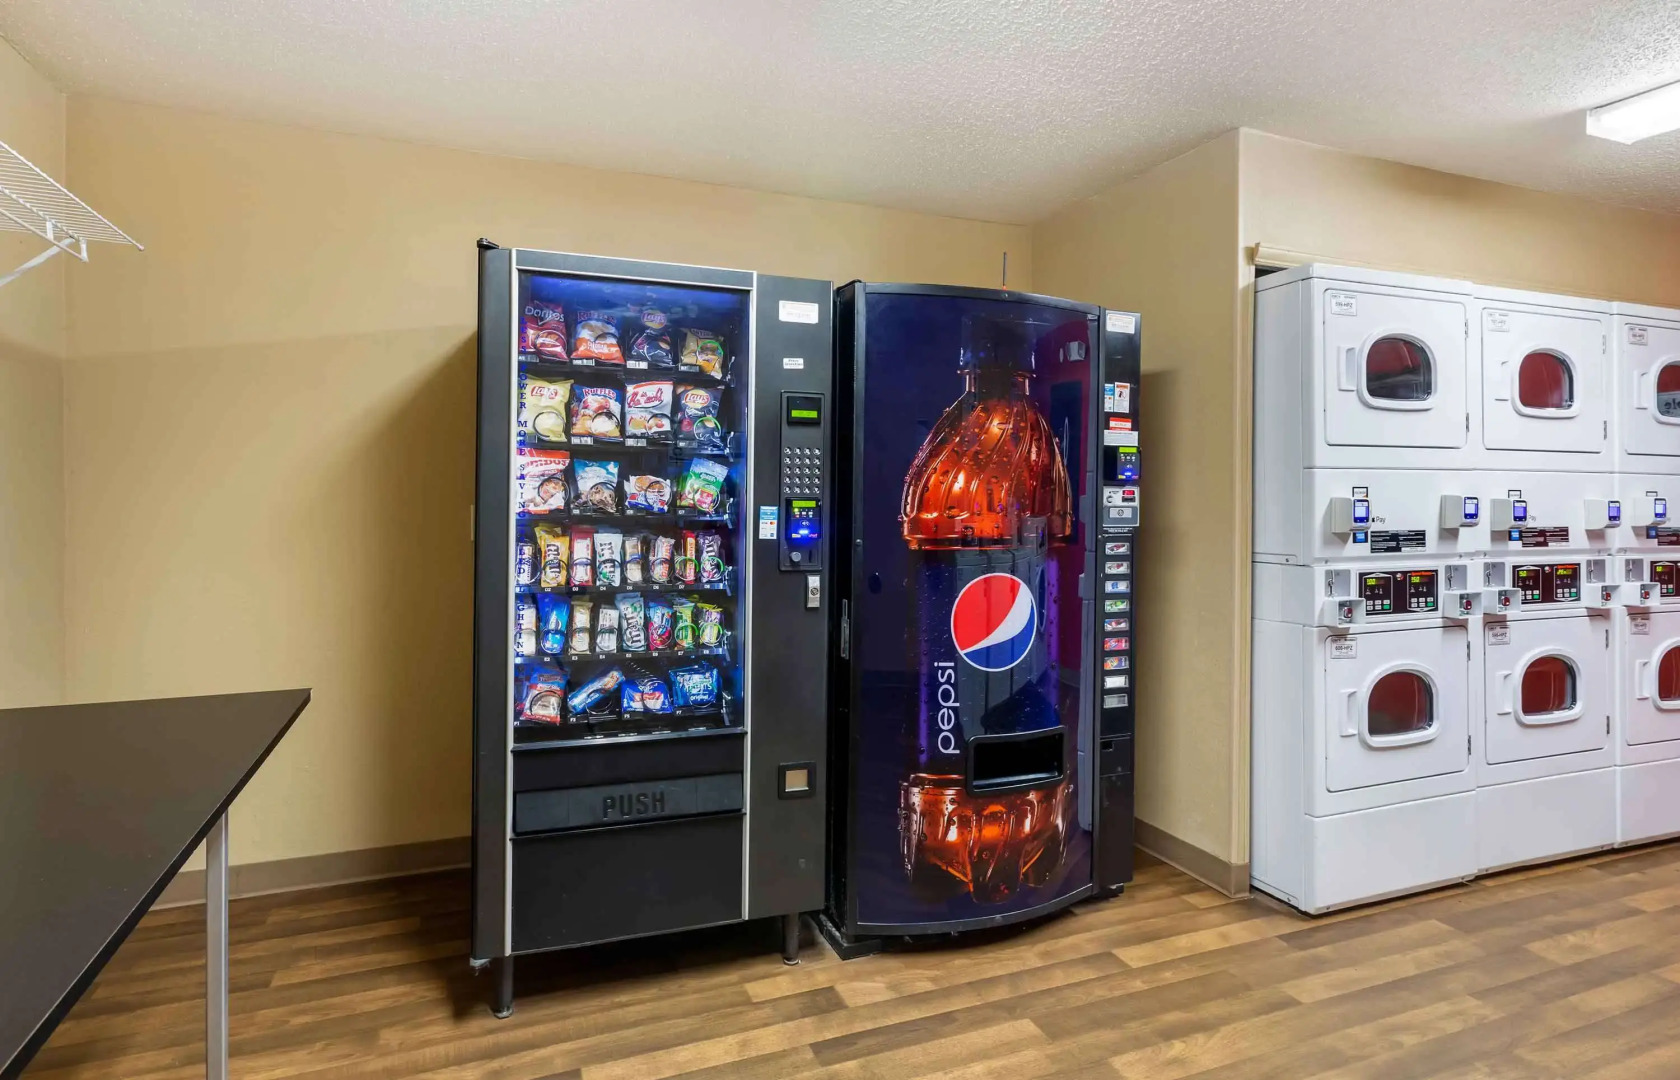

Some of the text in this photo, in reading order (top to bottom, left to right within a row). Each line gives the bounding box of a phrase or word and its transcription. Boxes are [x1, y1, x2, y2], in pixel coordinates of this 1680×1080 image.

[525, 305, 565, 322] Doritos
[519, 316, 527, 352] LESS
[519, 363, 528, 409] POWER
[582, 387, 617, 401] RUFFLES
[518, 420, 528, 456] MORE
[1376, 516, 1386, 524] Pay
[934, 662, 960, 754] pepsi
[602, 791, 665, 819] PUSH
